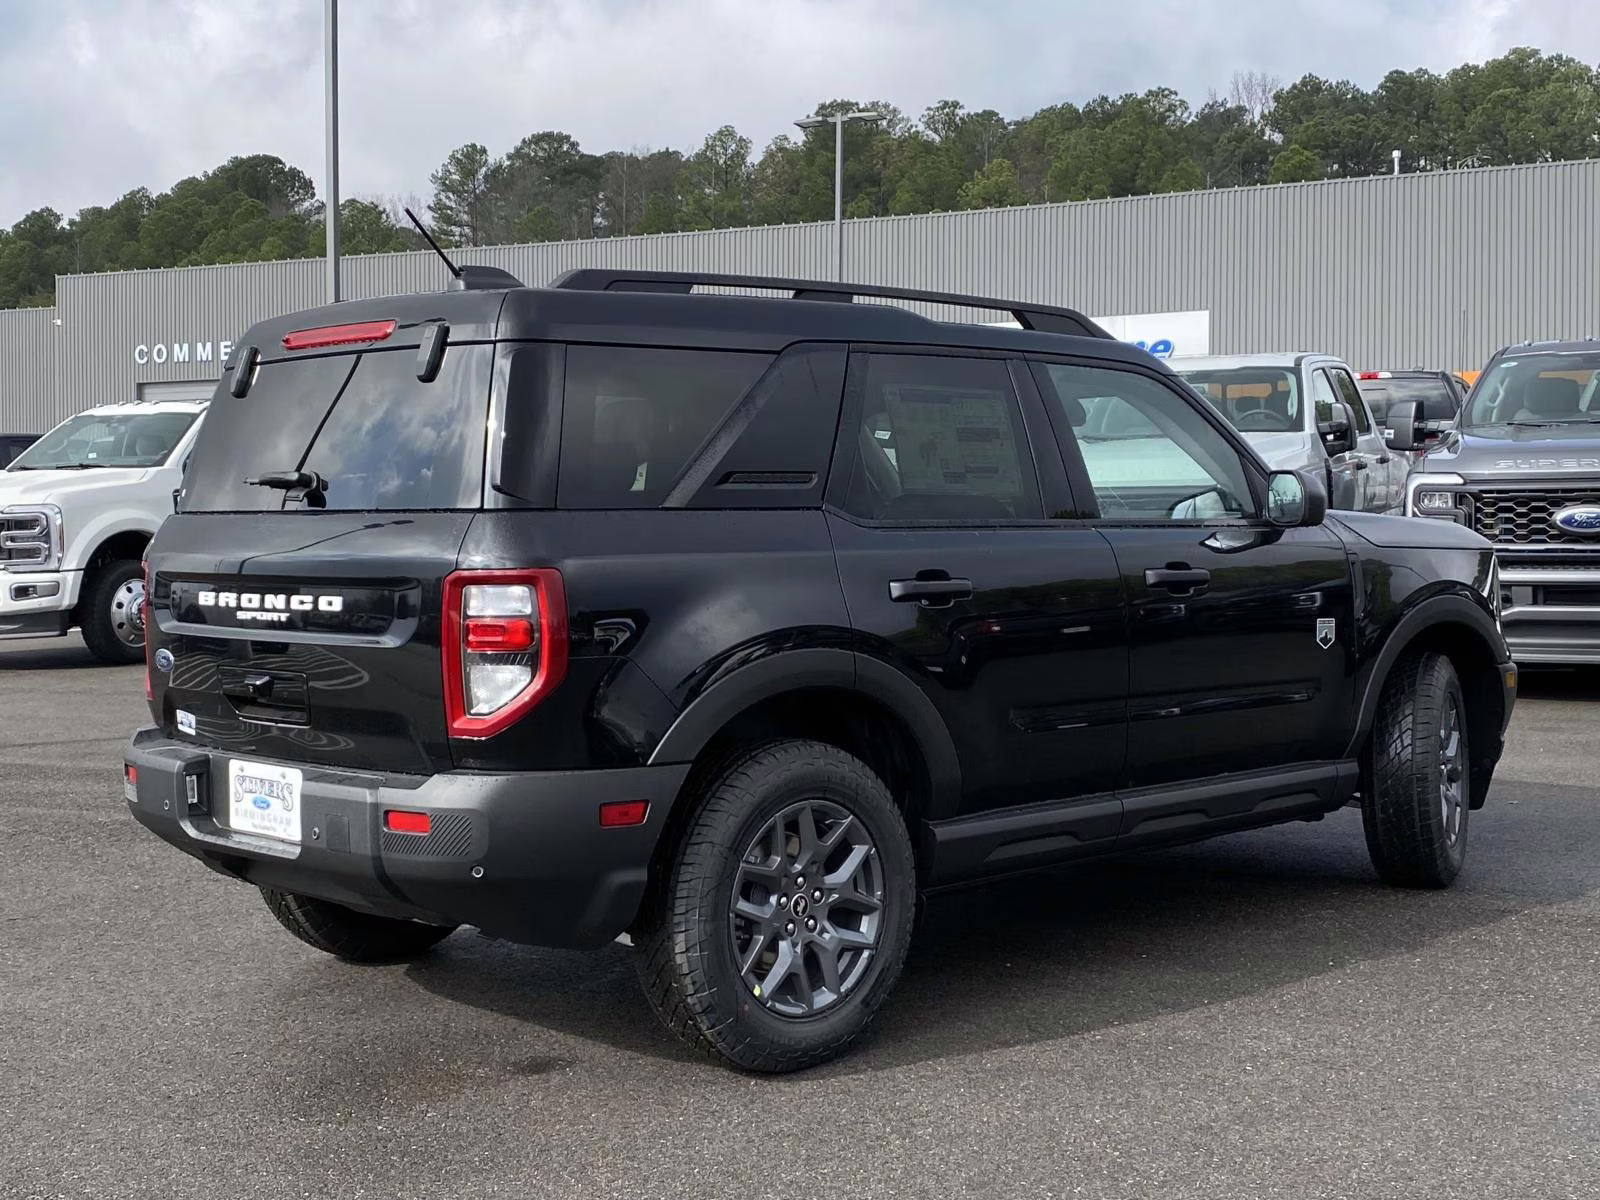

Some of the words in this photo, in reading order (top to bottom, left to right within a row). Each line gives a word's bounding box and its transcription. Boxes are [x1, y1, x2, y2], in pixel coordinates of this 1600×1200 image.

[134, 341, 232, 364] COMME
[1495, 458, 1600, 468] SUPER
[198, 590, 344, 612] BRONCO
[236, 611, 290, 622] SPORT
